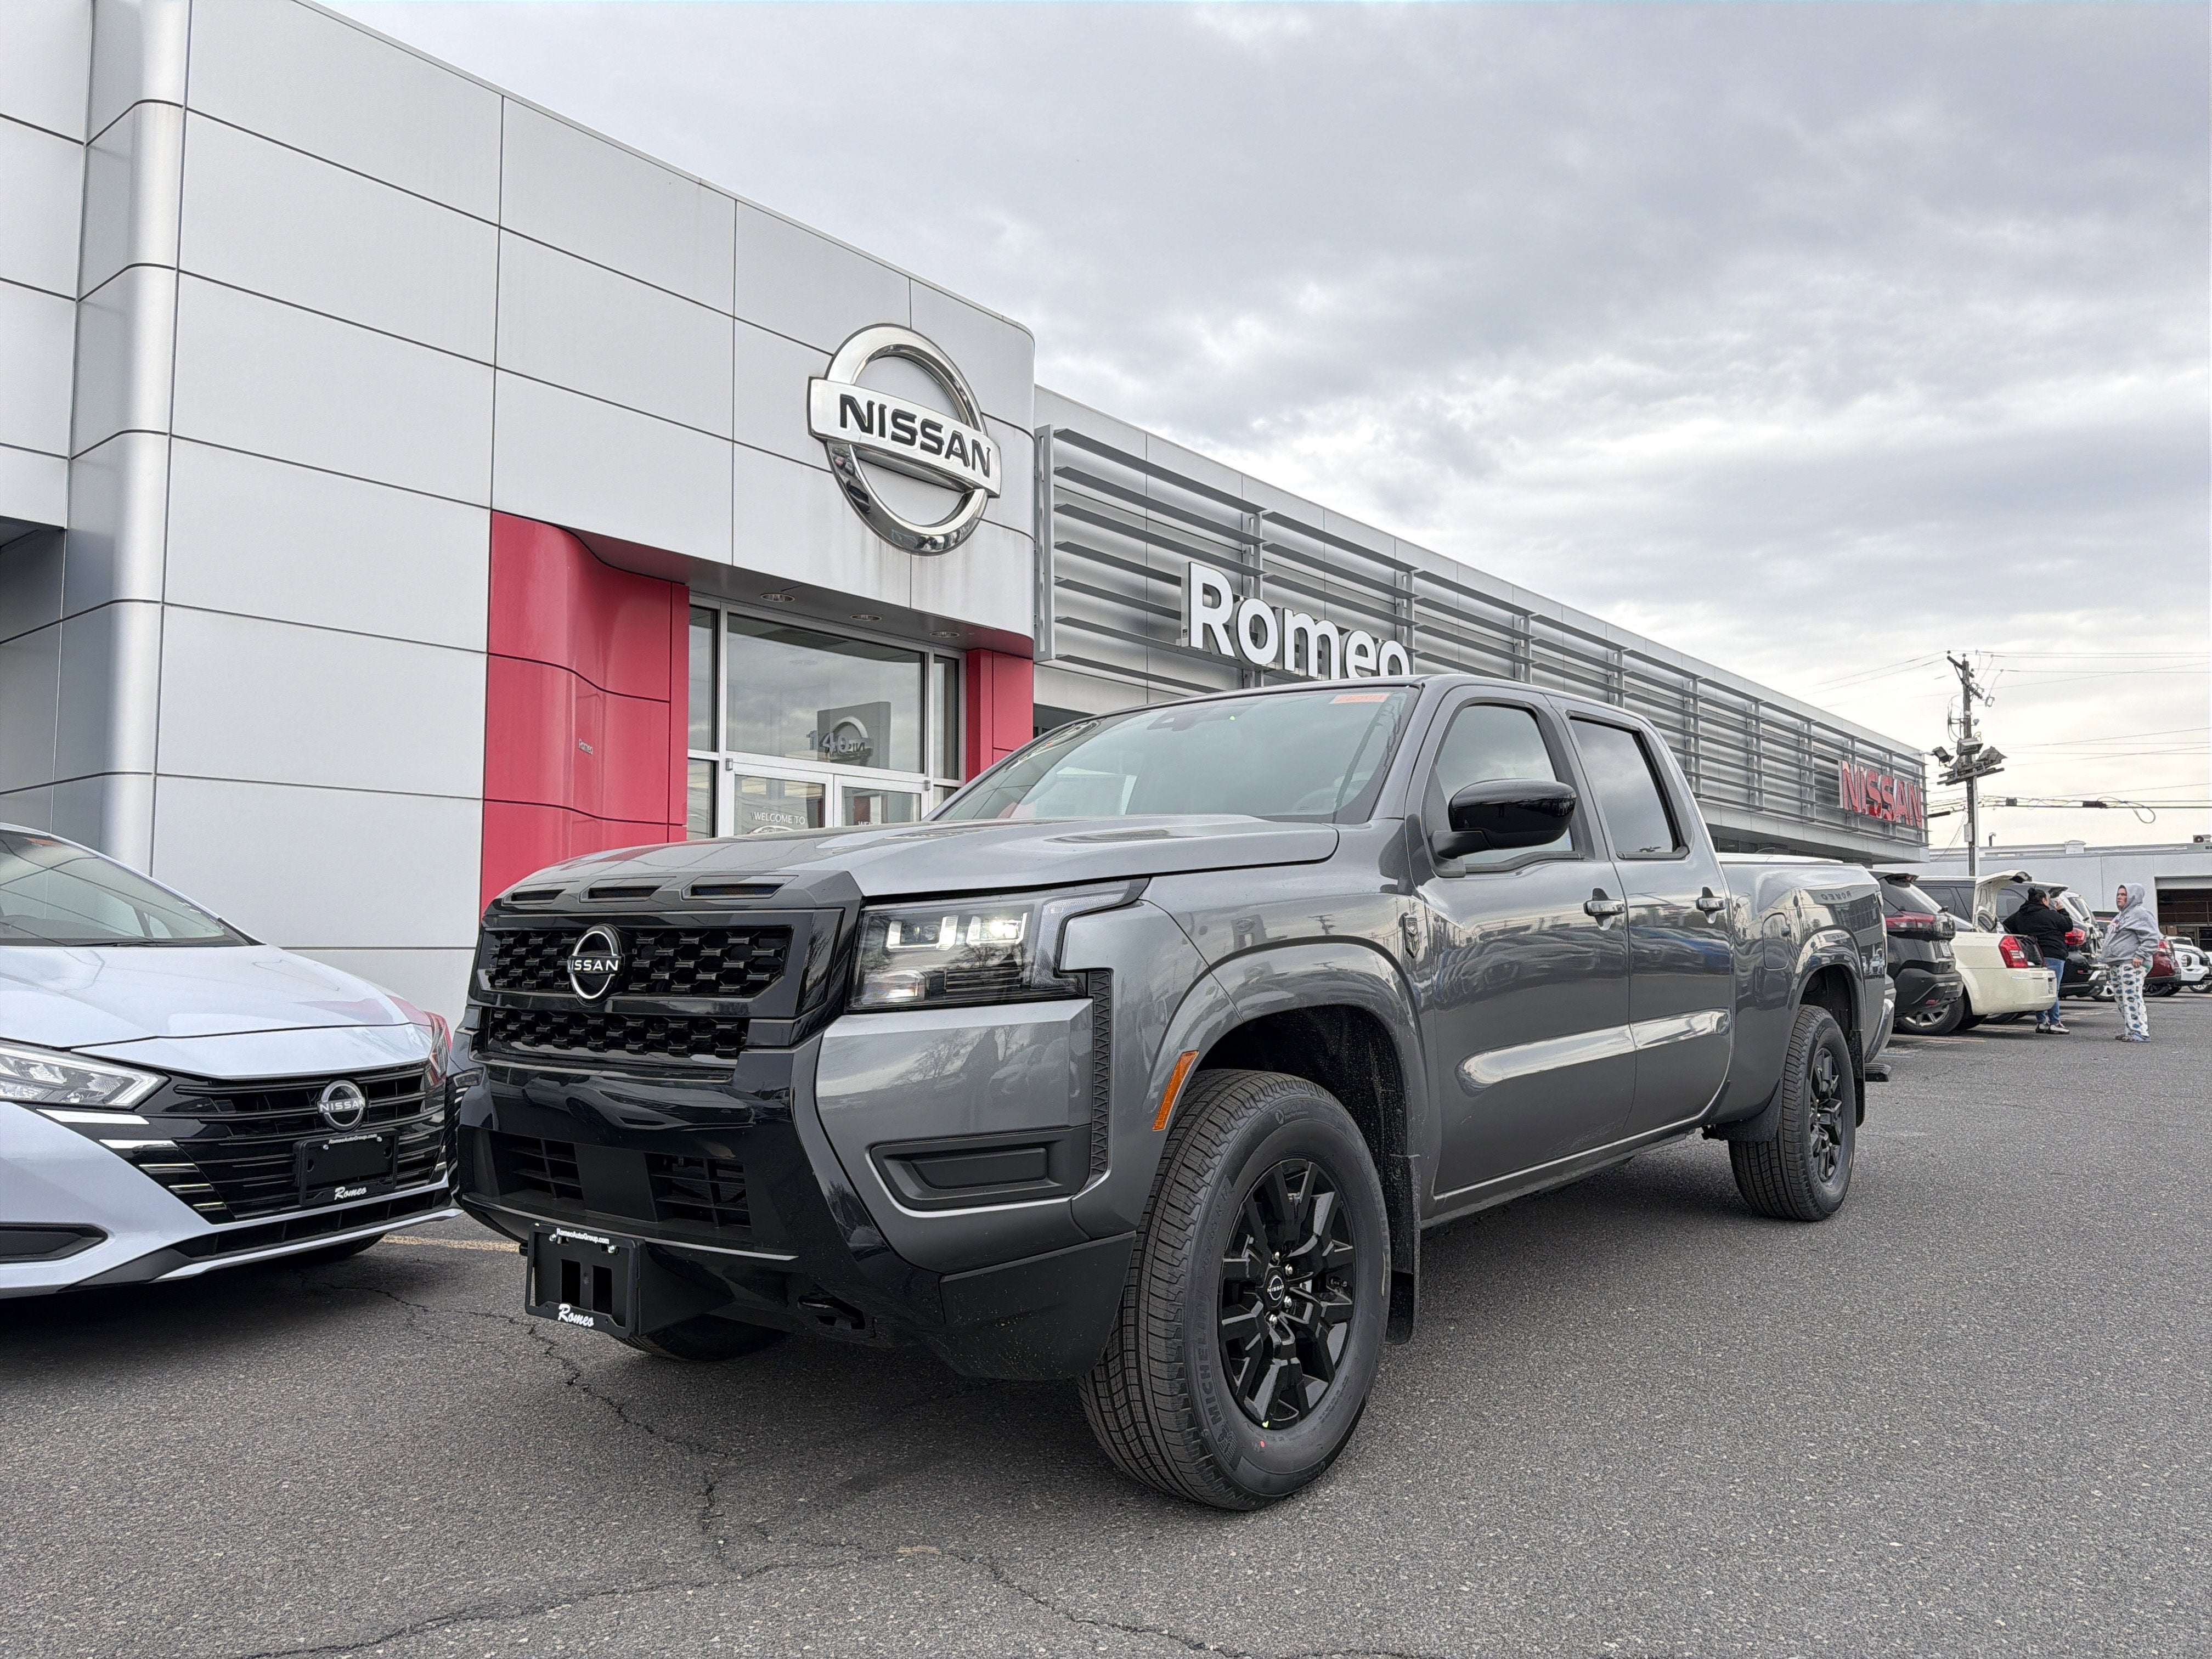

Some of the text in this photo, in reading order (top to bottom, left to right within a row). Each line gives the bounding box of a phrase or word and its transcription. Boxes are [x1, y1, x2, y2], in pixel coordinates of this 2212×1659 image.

[839, 393, 991, 479] NISSAN
[1188, 561, 1410, 680] Romeo
[808, 730, 849, 755] 140
[1841, 760, 1923, 829] NISSAN
[753, 811, 806, 826] WELCOME TO
[567, 960, 619, 971] NISSAN
[319, 1098, 365, 1112] NISSAN
[328, 1133, 377, 1145] RomeoAutoGroup.com
[334, 1186, 367, 1200] Romeo
[556, 1227, 610, 1245] RomeoAutoGroup.com
[557, 1303, 594, 1327] Romeo
[1196, 1295, 1223, 1426] MICHELIN
